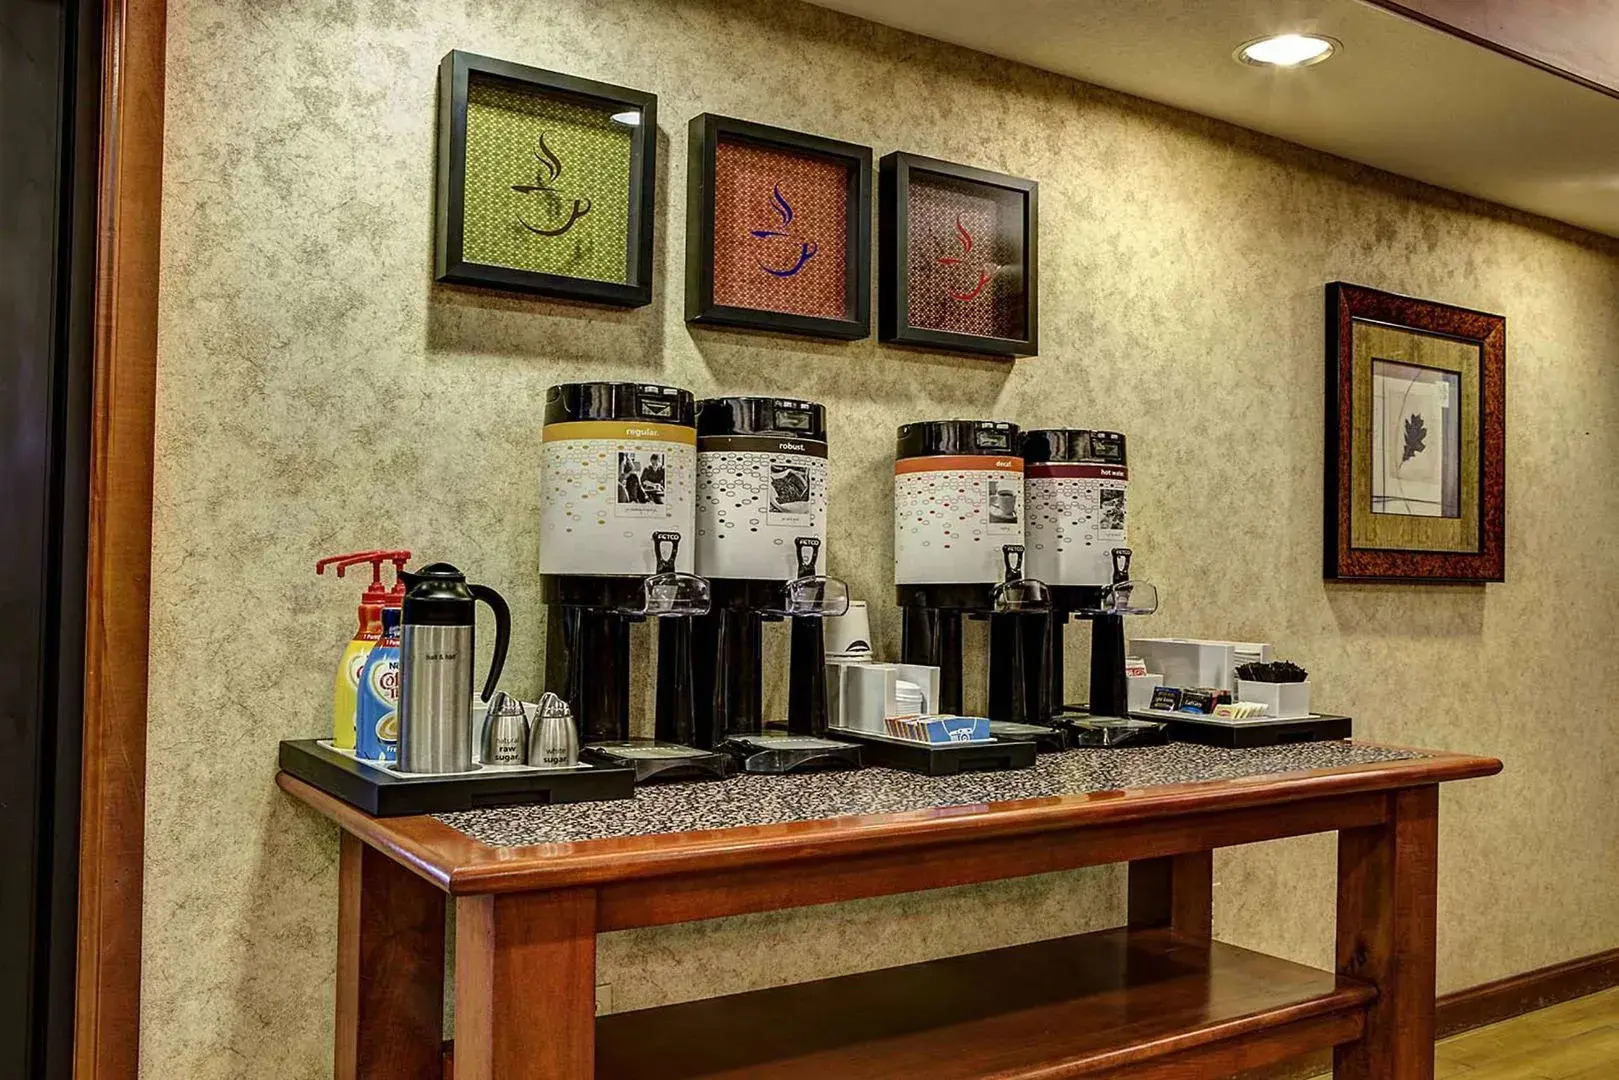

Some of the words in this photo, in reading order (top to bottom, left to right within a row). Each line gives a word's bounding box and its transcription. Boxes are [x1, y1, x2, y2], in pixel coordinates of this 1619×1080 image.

[779, 442, 806, 451] robust.
[1100, 468, 1112, 476] hot
[545, 746, 567, 754] white
